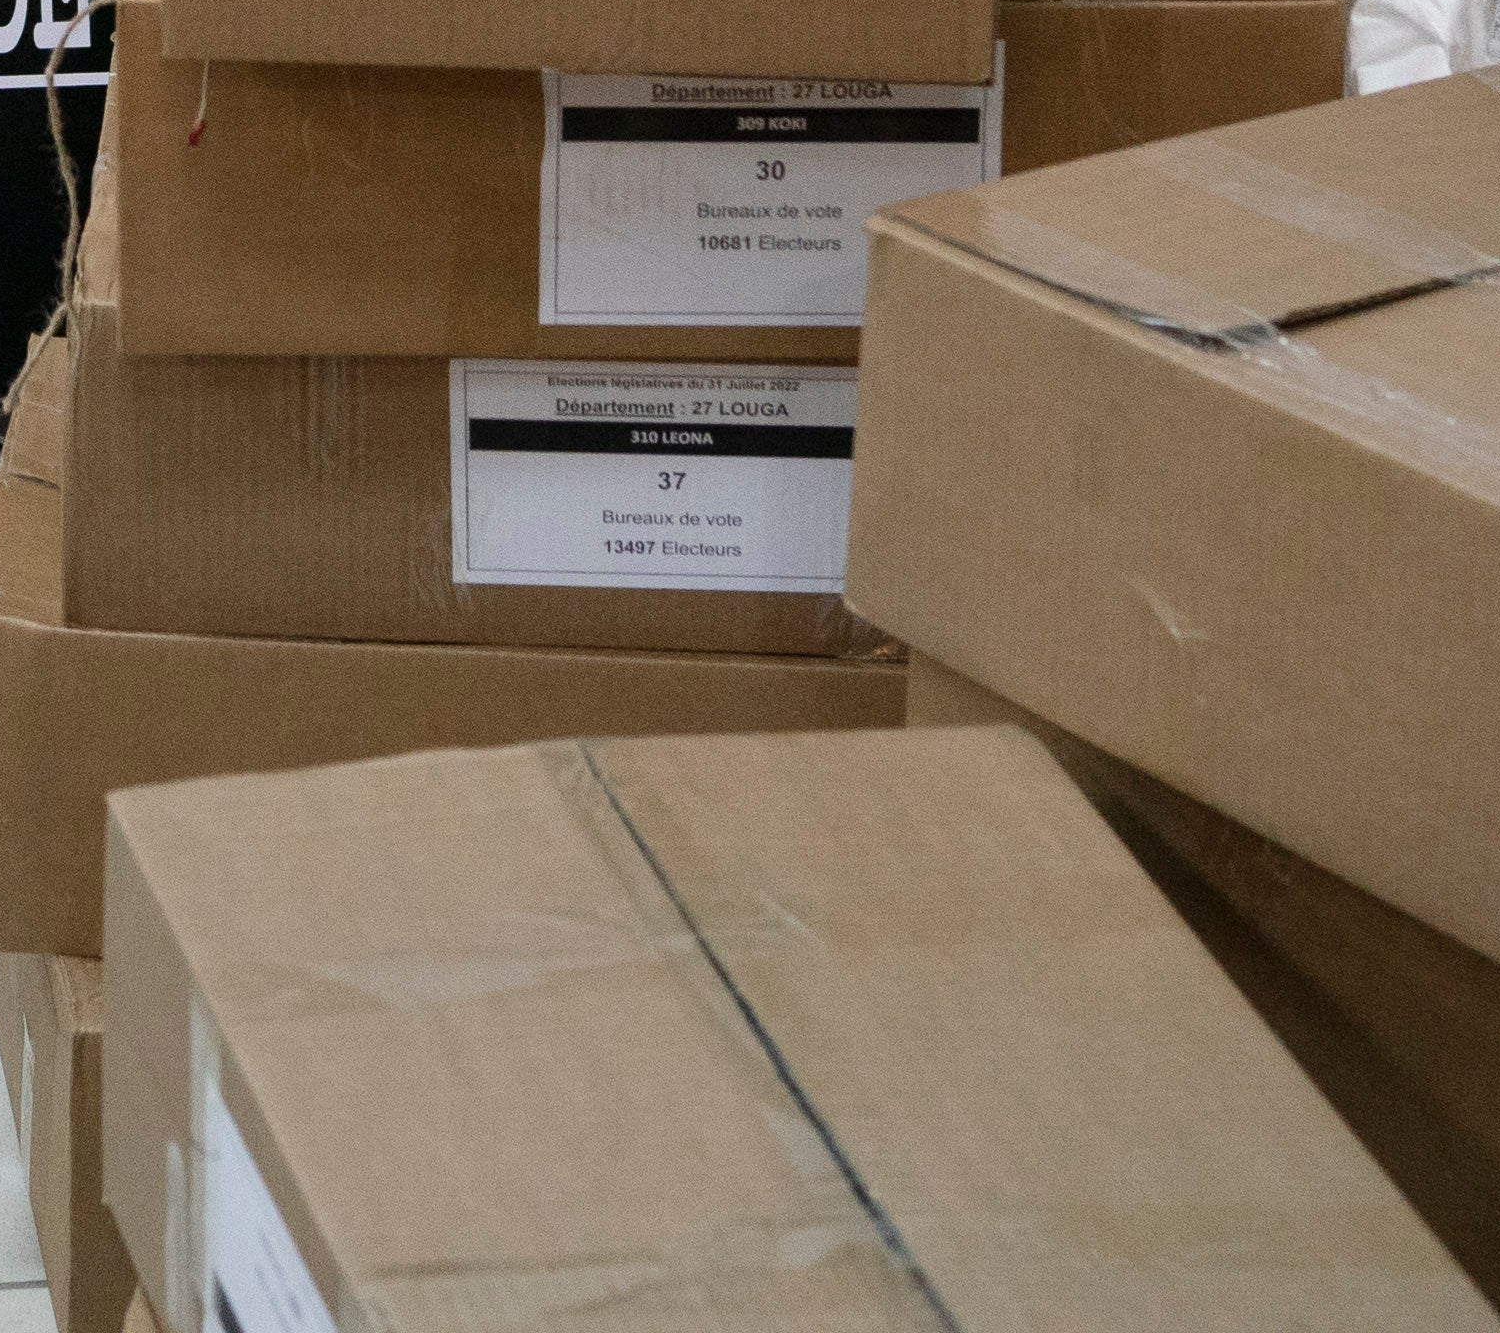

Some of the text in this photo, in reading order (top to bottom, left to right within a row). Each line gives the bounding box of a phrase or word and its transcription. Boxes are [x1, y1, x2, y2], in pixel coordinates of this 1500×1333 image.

[792, 85, 812, 99] 27
[820, 83, 893, 99] LOUGA
[737, 117, 807, 131] 309 KOKI
[756, 160, 786, 181] 30
[696, 202, 843, 219] Bureaux de vote
[700, 236, 842, 252] 10681 Electeurs
[687, 379, 703, 390] du
[555, 398, 675, 418] Département
[692, 401, 713, 416] 27
[719, 402, 789, 417] LOUGA
[630, 430, 714, 445] 310 LEONA
[658, 472, 687, 491] 37
[602, 509, 743, 527] Bureaux de vote
[604, 540, 742, 557] 13497 Electeurs
